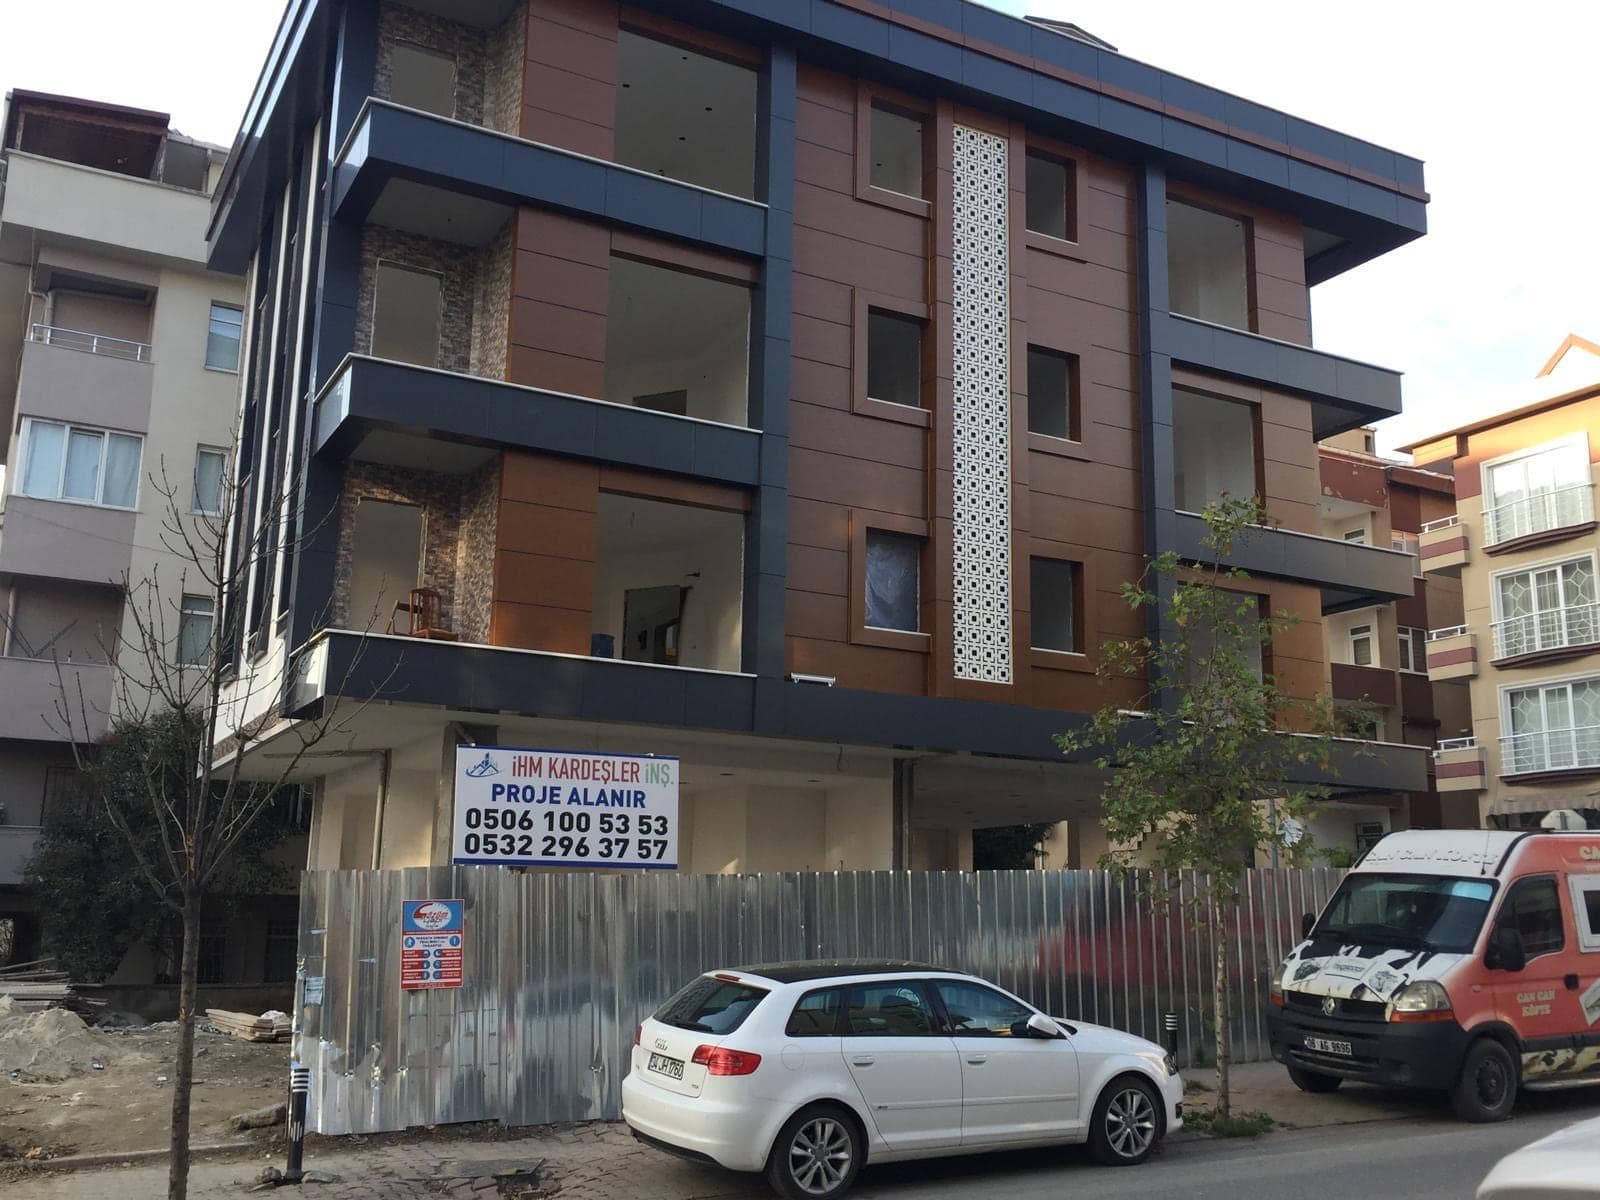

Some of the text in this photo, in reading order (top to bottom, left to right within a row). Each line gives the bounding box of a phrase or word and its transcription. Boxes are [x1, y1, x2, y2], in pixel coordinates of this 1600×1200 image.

[549, 757, 640, 785] KARDEŞLER
[491, 783, 646, 809] PROJE ALANIR
[466, 808, 668, 836] 0506 100 53 53
[464, 833, 668, 860] 0532 296 37 57
[1517, 990, 1556, 1004] CAN CAN
